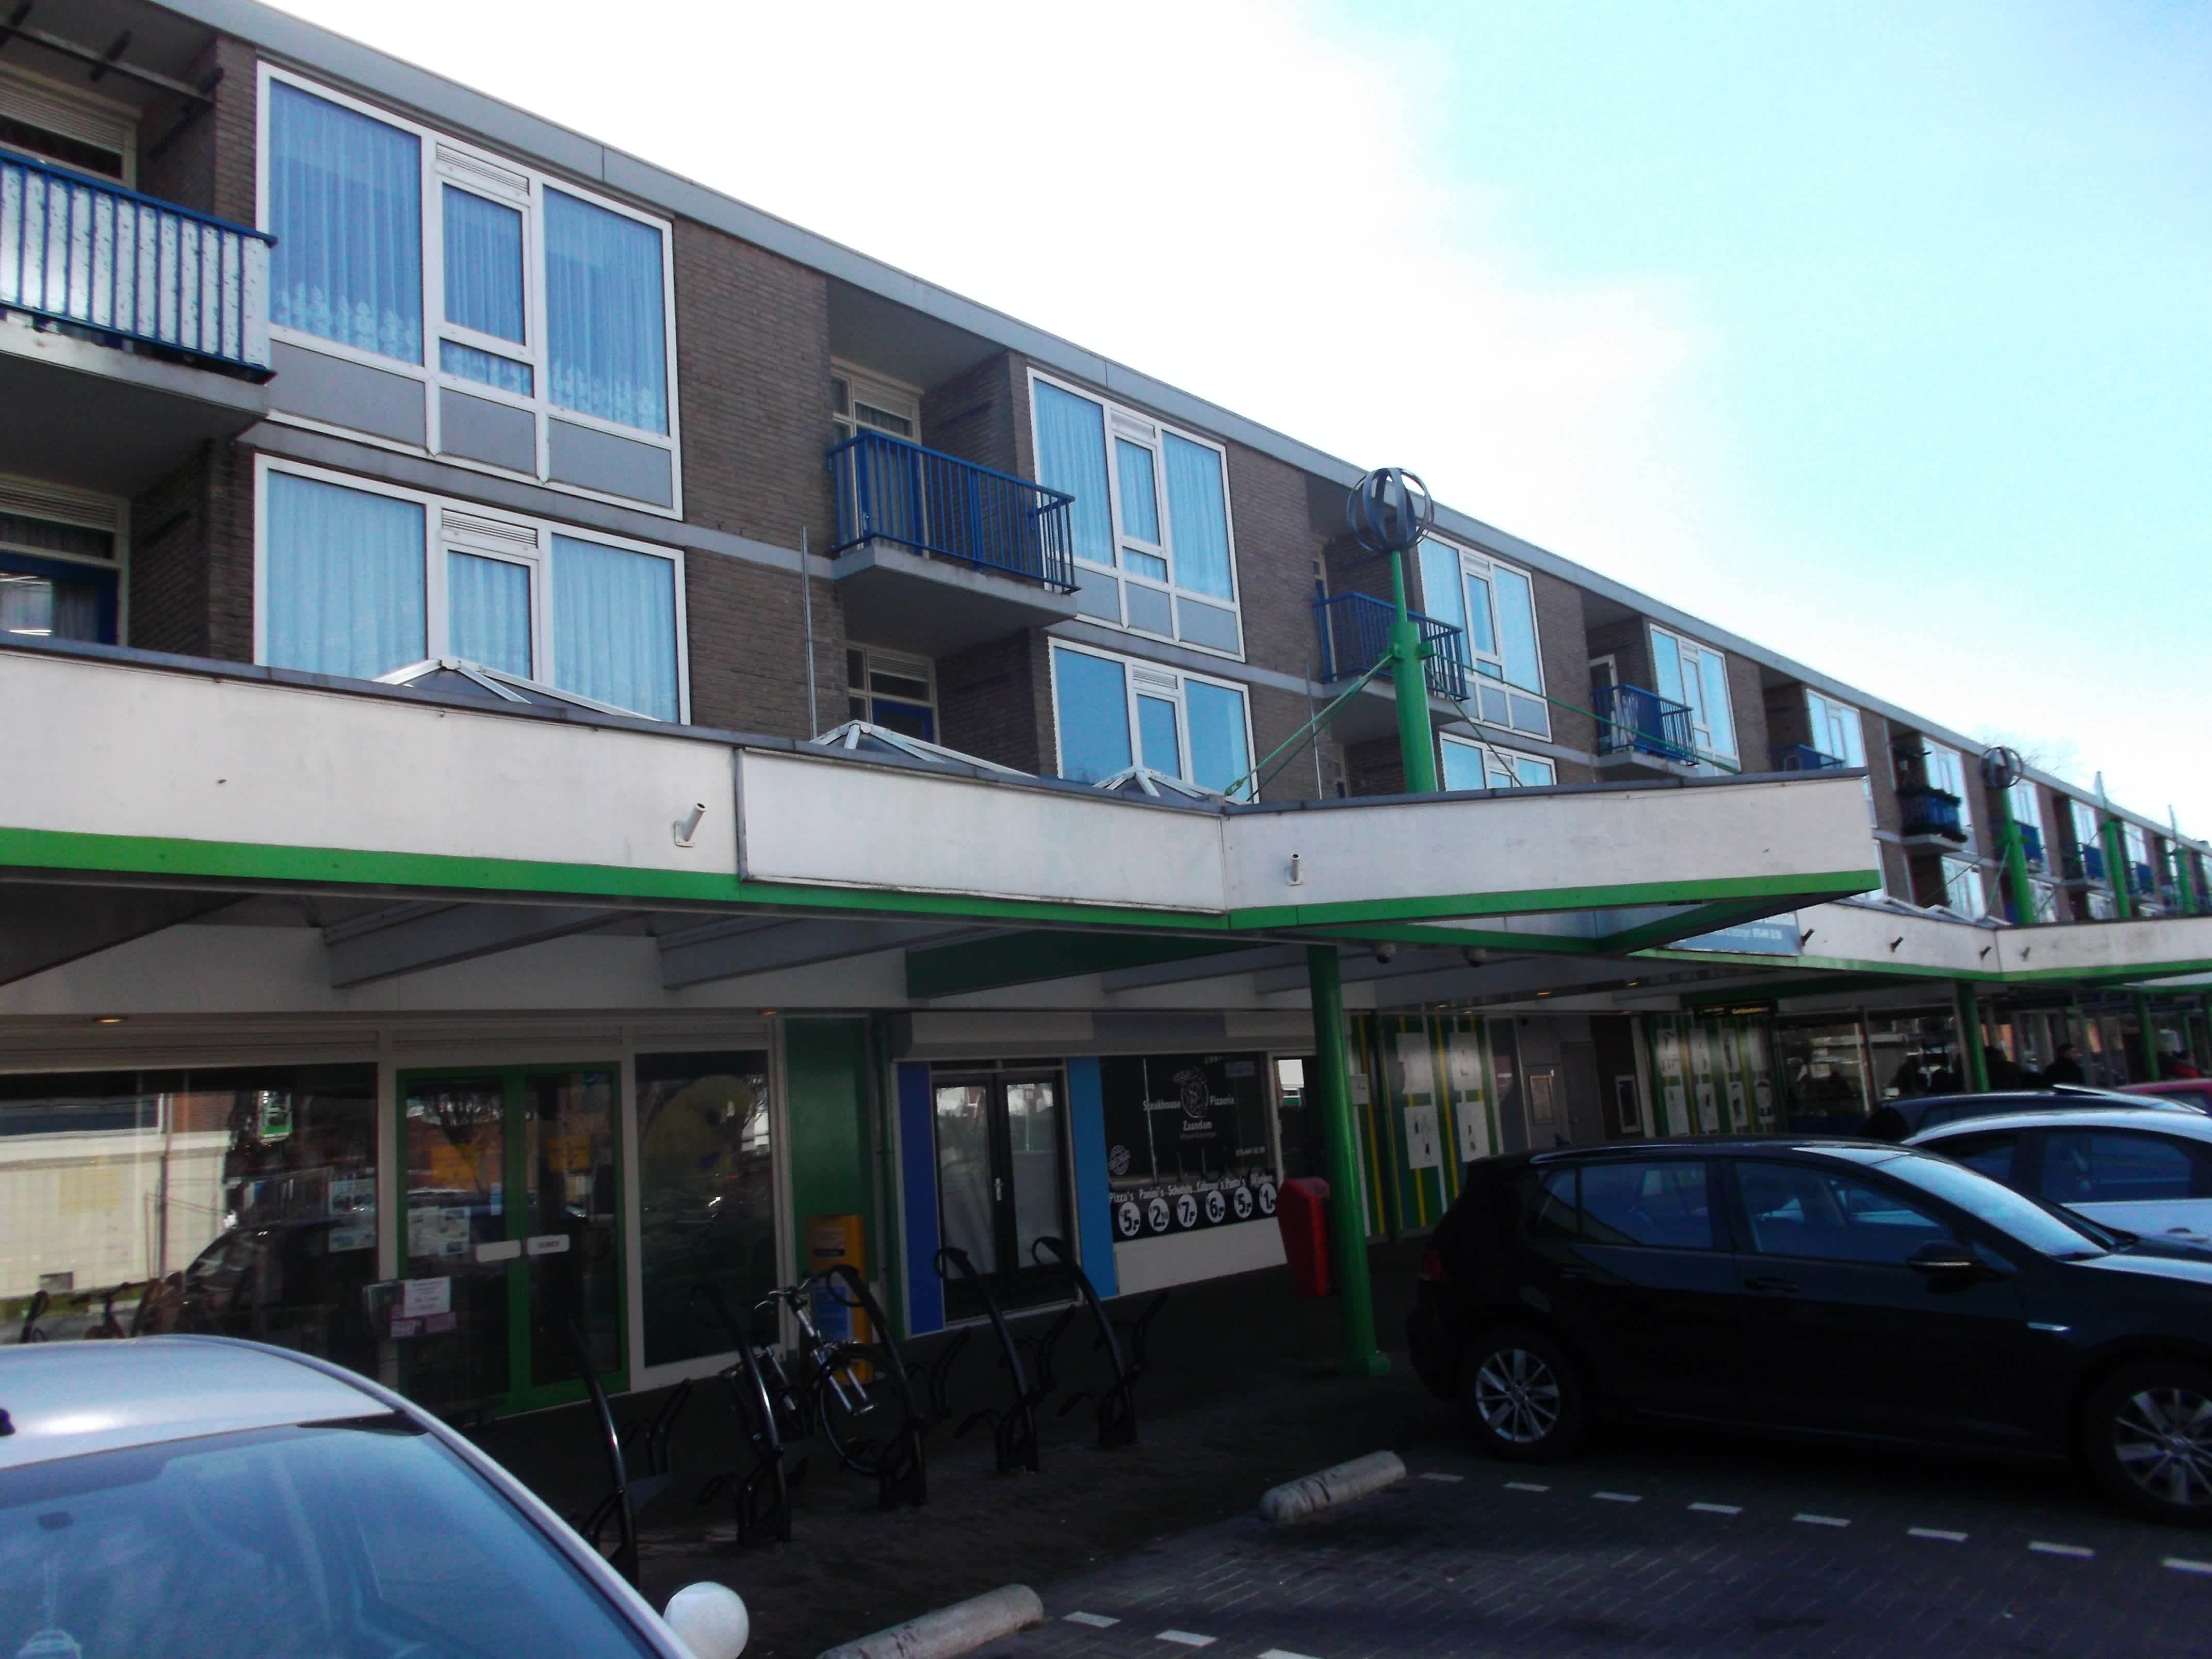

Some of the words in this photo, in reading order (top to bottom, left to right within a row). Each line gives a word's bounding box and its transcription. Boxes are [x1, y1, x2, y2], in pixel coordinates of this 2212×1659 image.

[1143, 1099, 1181, 1111] Steakhouse
[1209, 1094, 1235, 1107] Pizzeria
[1182, 1119, 1212, 1131] Zaandam
[1109, 1190, 1134, 1204] Pizza's
